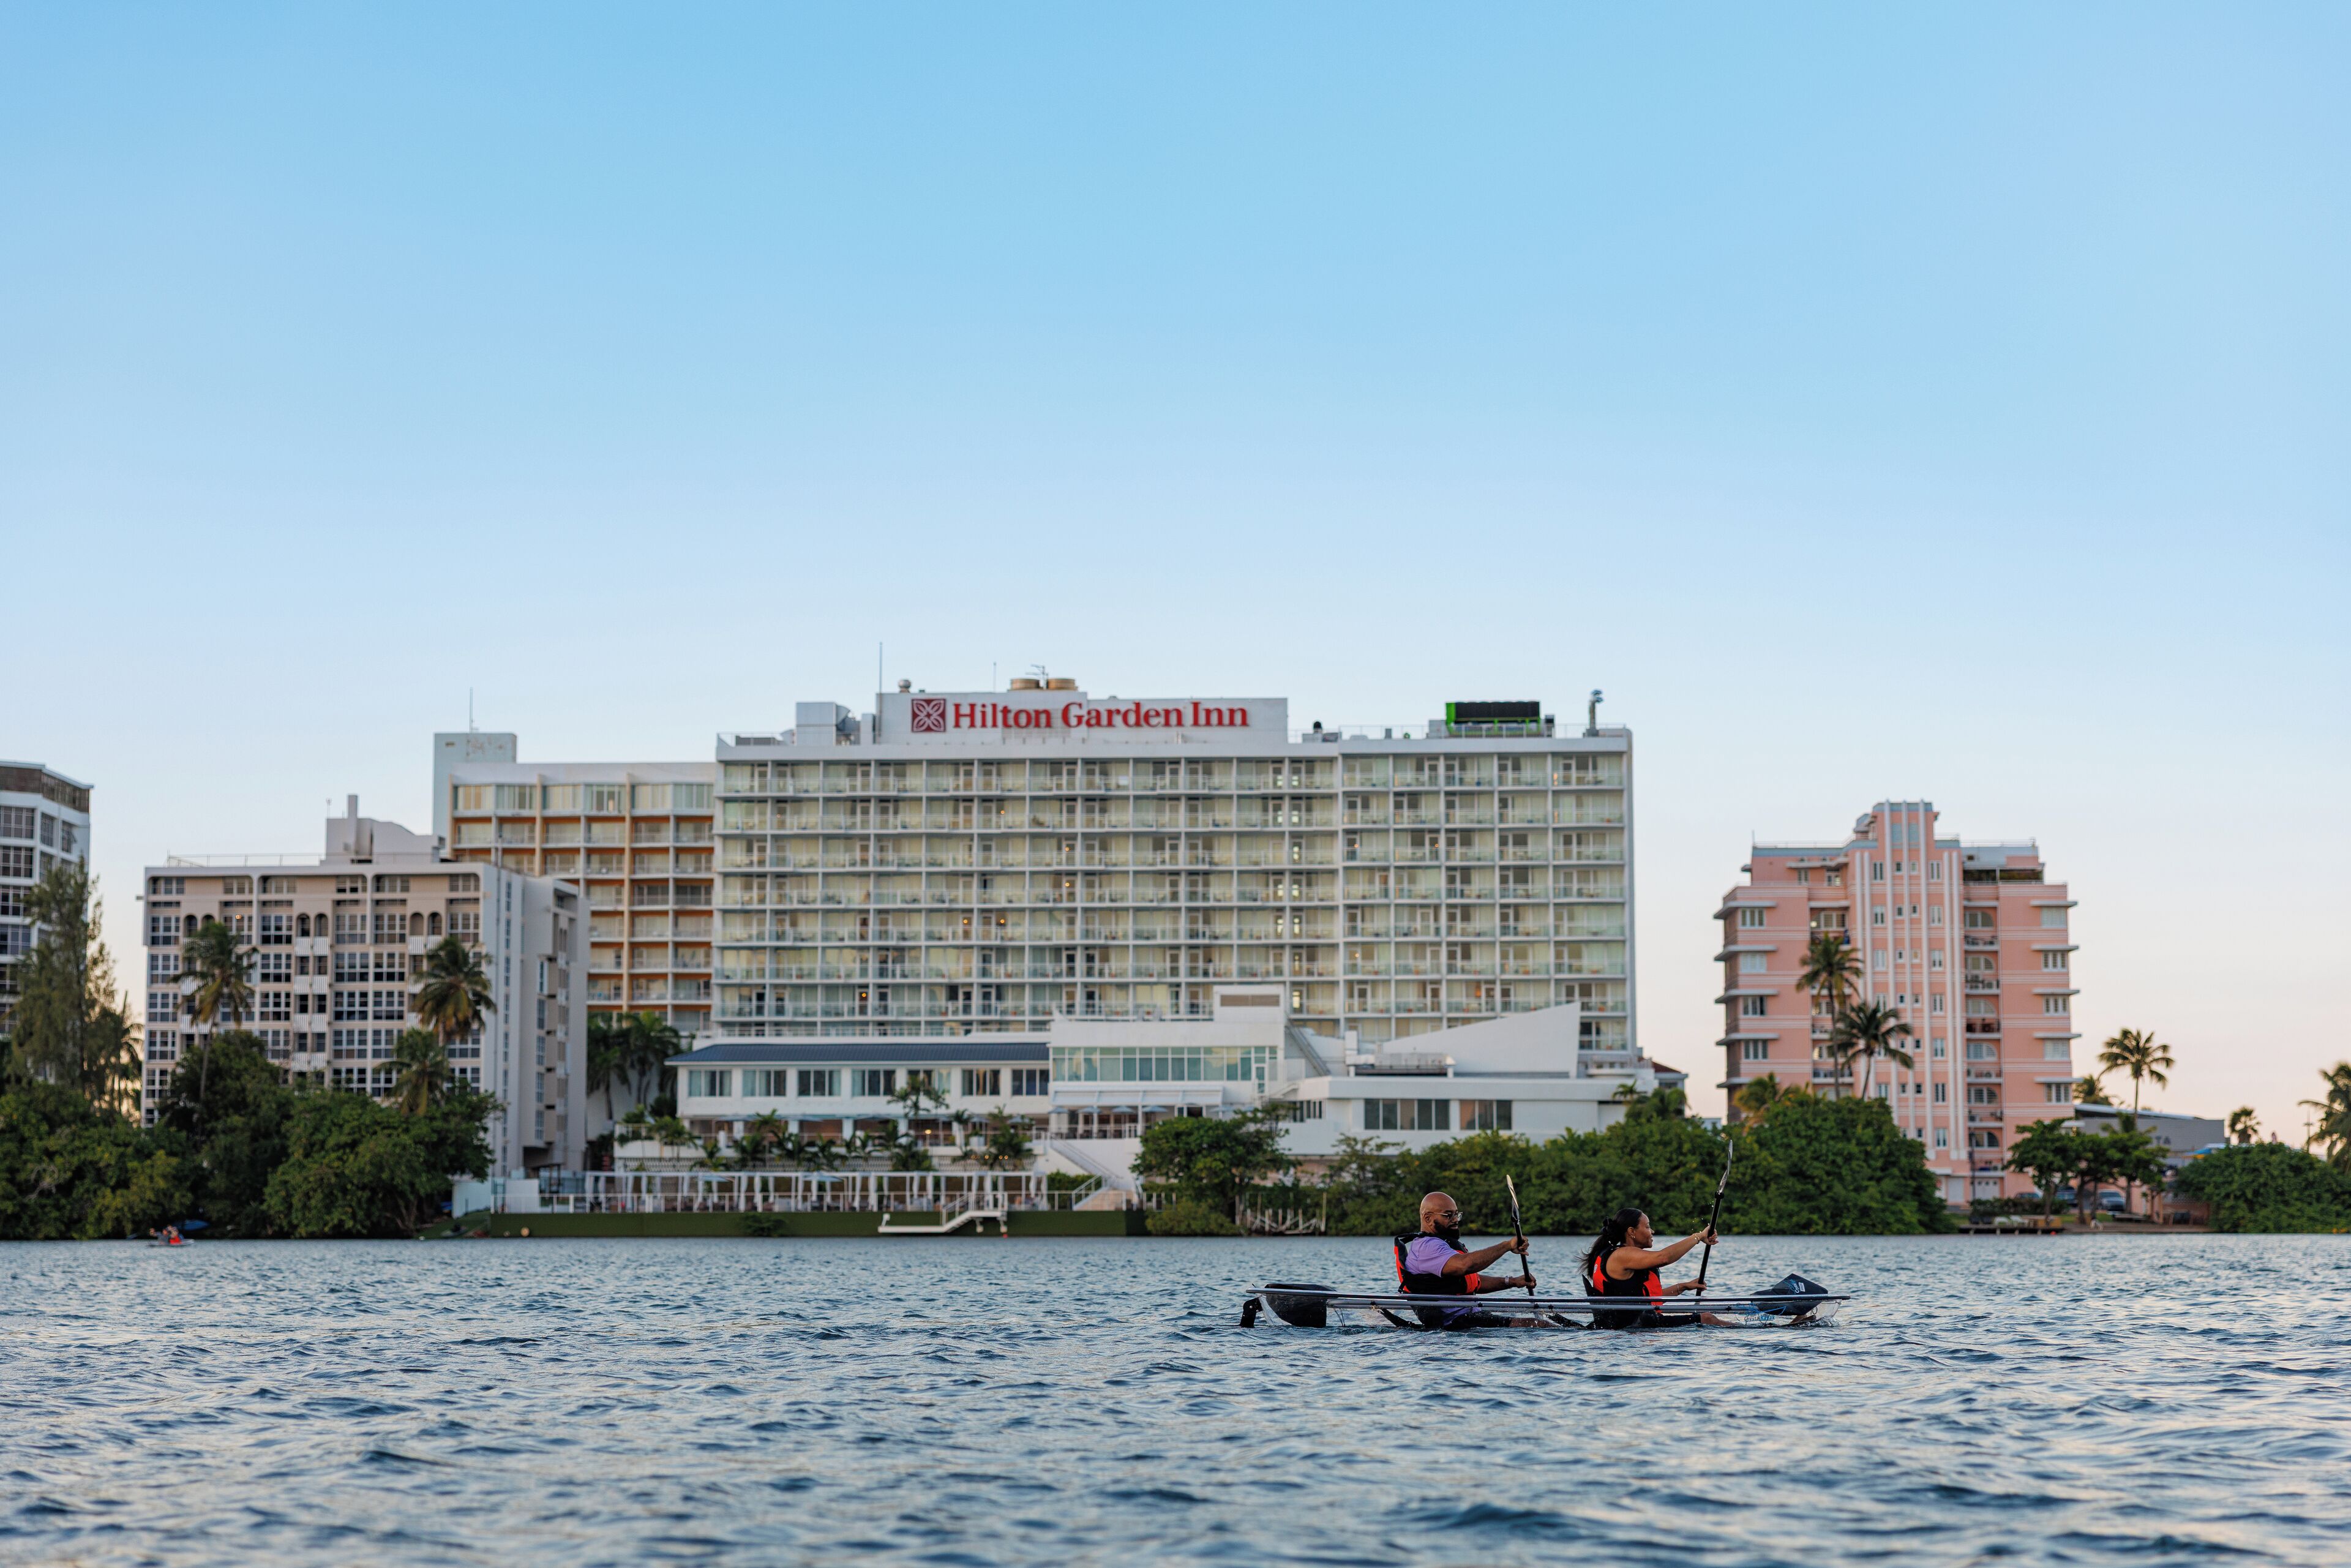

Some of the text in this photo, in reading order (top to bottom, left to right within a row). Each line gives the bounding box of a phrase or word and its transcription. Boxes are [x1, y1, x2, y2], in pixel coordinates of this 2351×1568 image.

[953, 701, 1249, 728] Hilton Garden Inn
